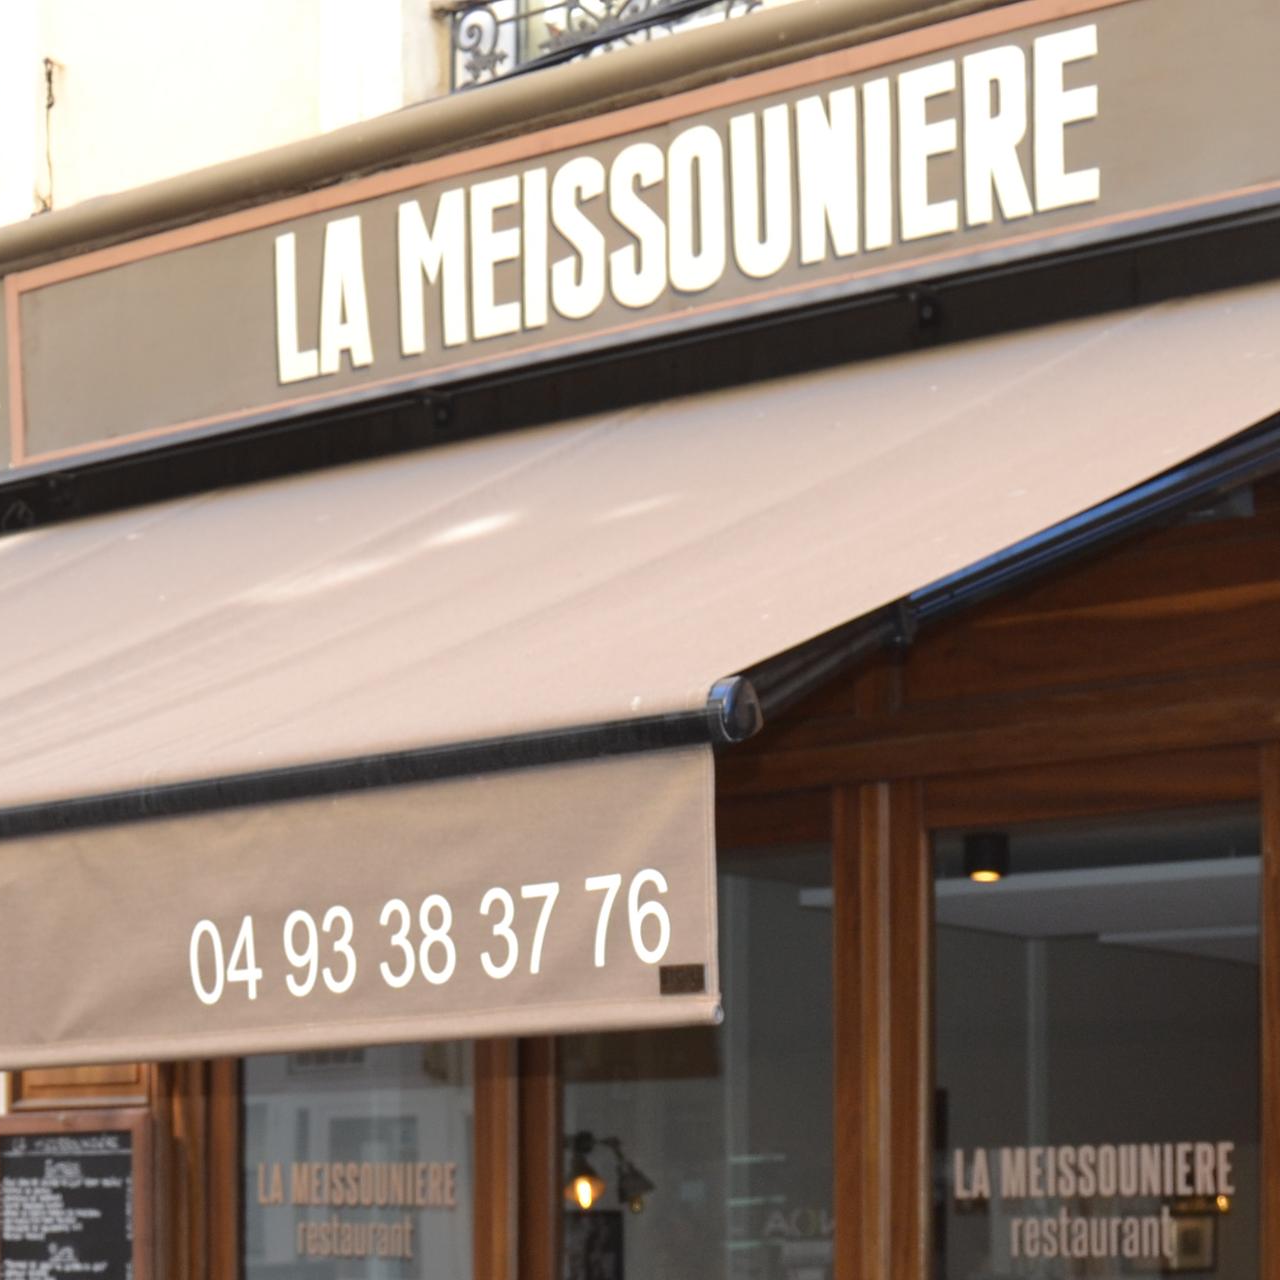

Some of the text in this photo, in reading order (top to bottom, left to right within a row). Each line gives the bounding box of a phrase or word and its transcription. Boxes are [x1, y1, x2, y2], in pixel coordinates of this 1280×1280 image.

[275, 23, 1101, 384] LA MEISSOUNIERE
[188, 867, 672, 1005] 04 93 38 37 76
[258, 1161, 457, 1206] LA MEISSOUNIERE
[953, 1141, 1235, 1199] LA MEISSOUNIERE
[297, 1215, 414, 1258] restaurant
[1009, 1206, 1176, 1258] restaurant
